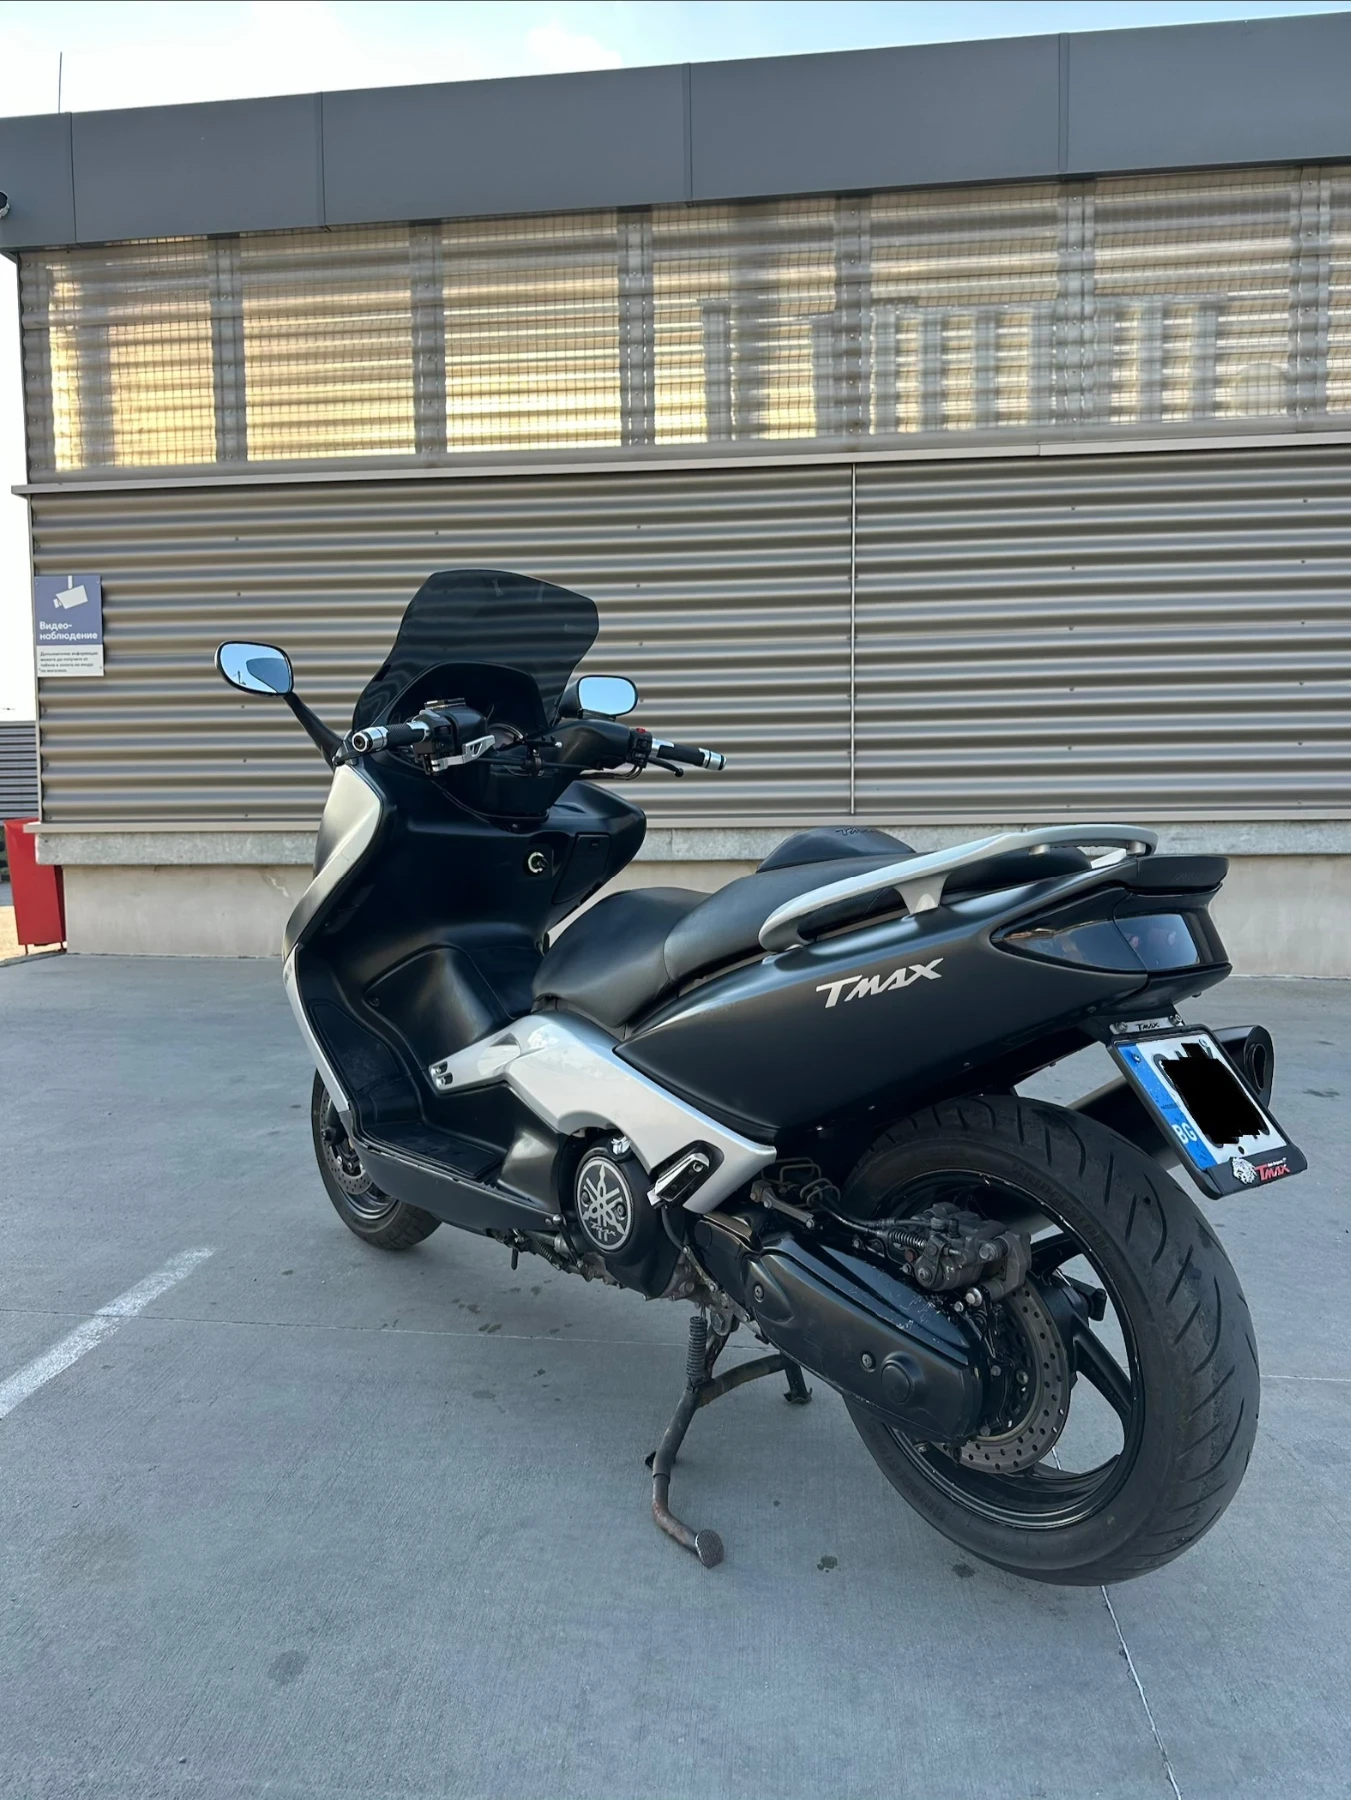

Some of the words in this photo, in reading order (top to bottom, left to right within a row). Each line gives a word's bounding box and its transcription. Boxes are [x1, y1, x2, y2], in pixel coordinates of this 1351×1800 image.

[39, 621, 73, 631] Видео-
[39, 631, 98, 641] наблюдение
[815, 957, 944, 1009] TMAX
[1171, 1122, 1198, 1145] BG
